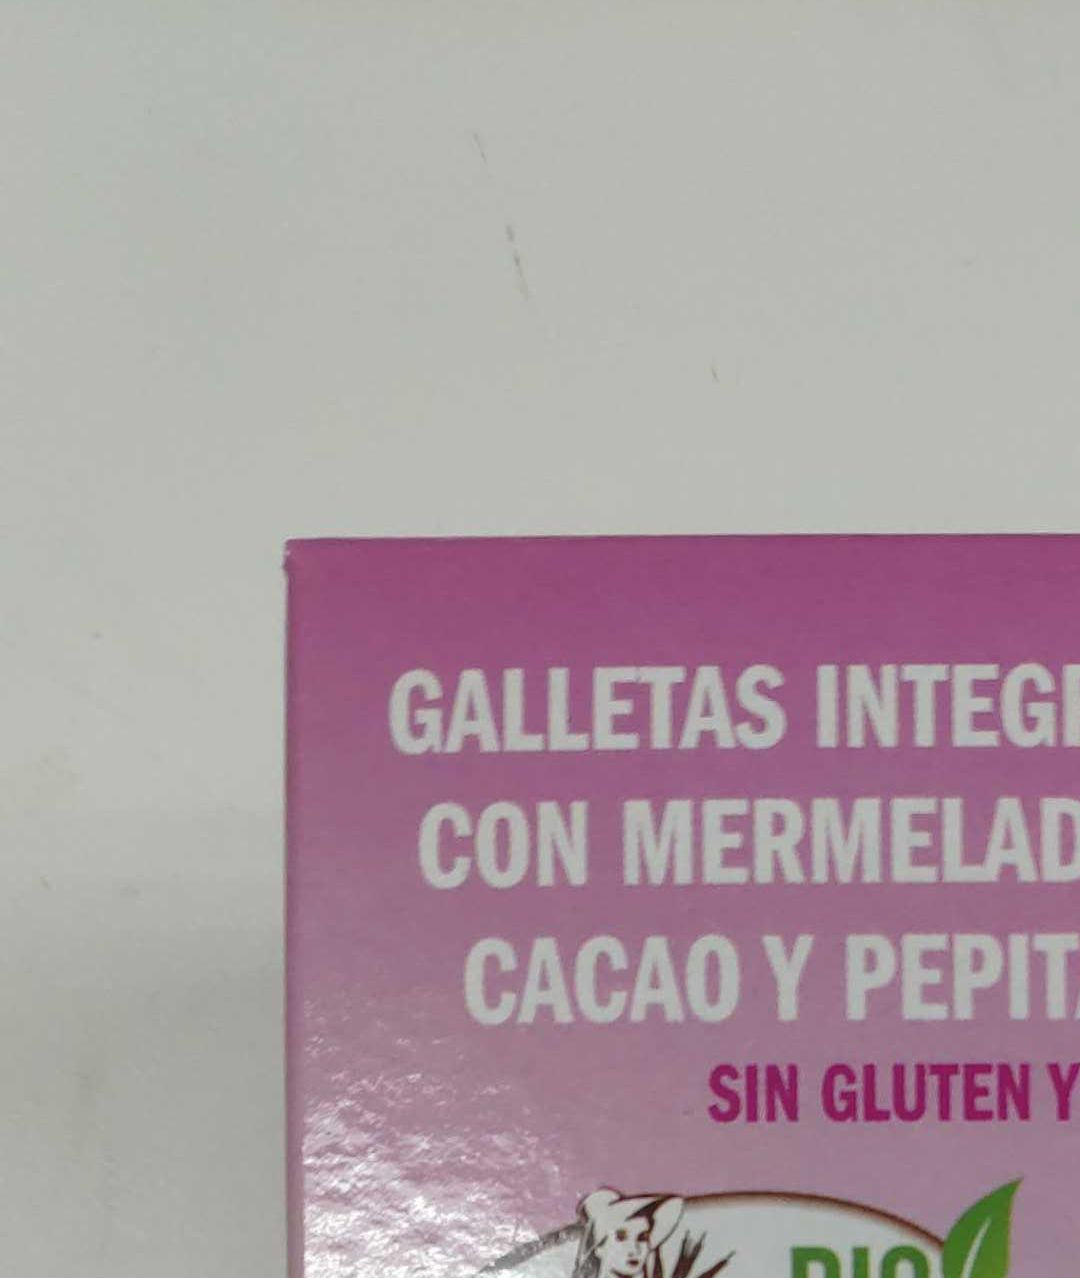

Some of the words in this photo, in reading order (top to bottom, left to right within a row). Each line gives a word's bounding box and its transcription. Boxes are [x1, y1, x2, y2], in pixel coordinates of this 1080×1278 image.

[389, 664, 787, 754] GALLETAS
[417, 800, 589, 889] CON
[463, 934, 741, 1026] CACAO
[762, 933, 815, 1022] Y
[707, 1063, 799, 1123] SIN
[821, 1062, 1031, 1123] GLUTEN
